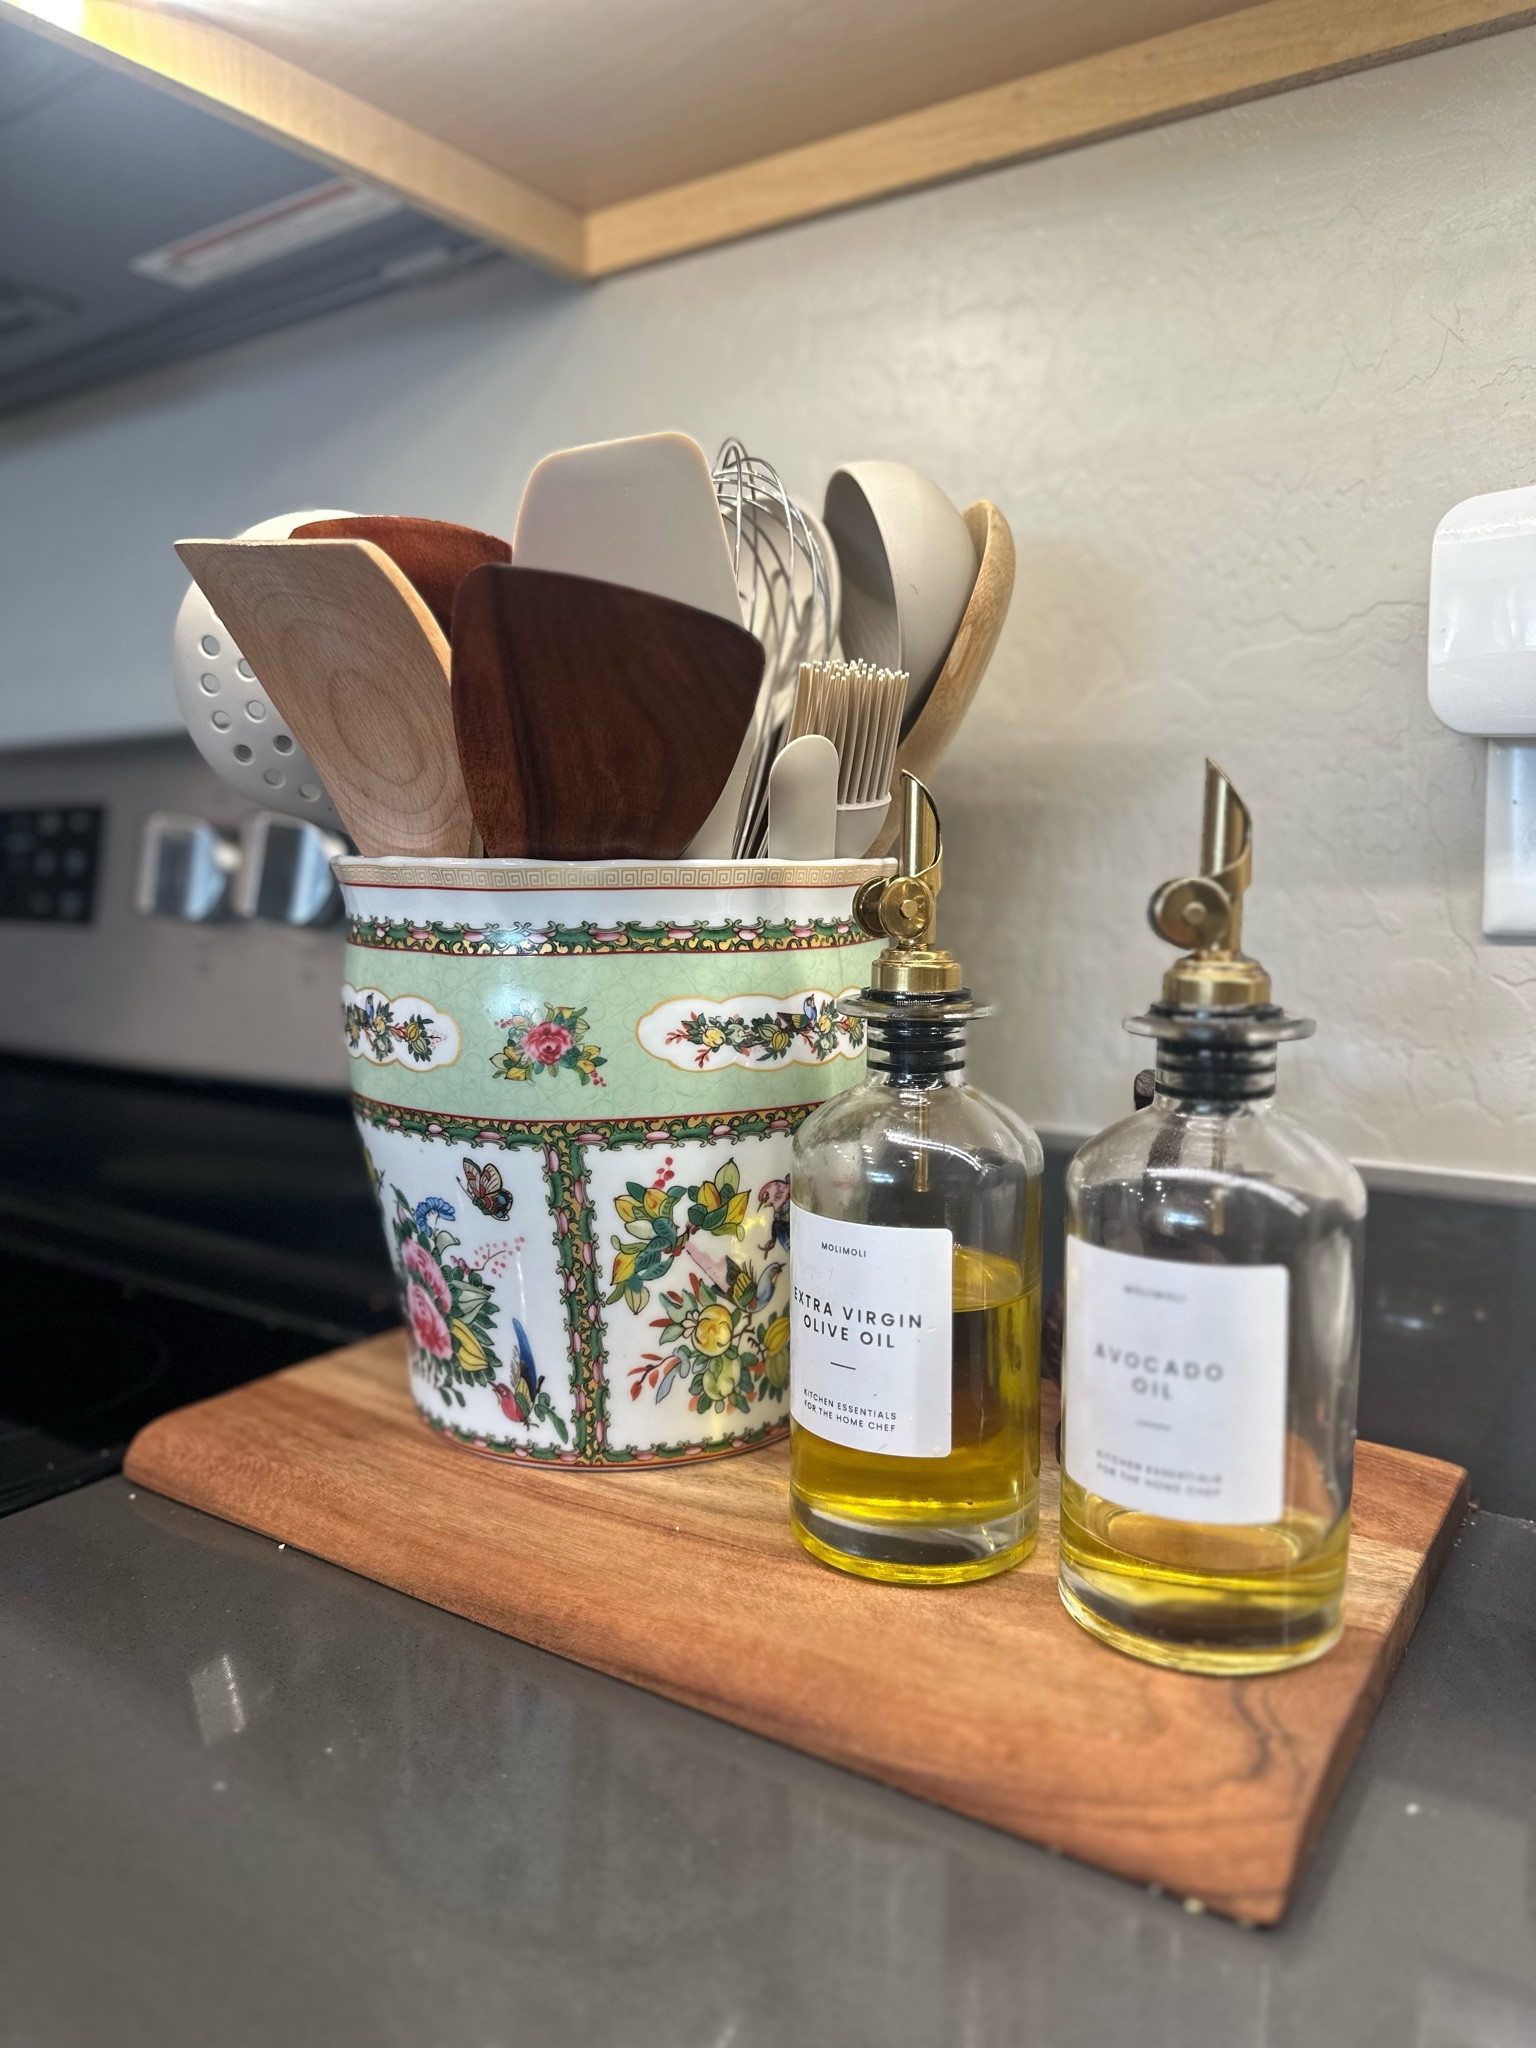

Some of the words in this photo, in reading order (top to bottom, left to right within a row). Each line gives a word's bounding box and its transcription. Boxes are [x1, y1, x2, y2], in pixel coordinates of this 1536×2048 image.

[821, 1241, 867, 1258] MOLIMOLI
[793, 1286, 833, 1317] EXTRA
[842, 1306, 923, 1329] VIRGIN
[803, 1314, 849, 1342] OLIVE
[859, 1331, 895, 1349] OIL
[1094, 1342, 1224, 1382] AVOCADO
[803, 1387, 834, 1408] KITCHEN
[837, 1401, 897, 1421] ESSENTIALS
[1132, 1377, 1172, 1400] OIL
[804, 1399, 817, 1413] FOR
[818, 1407, 834, 1420] THE
[836, 1413, 864, 1429] HOME
[867, 1420, 896, 1433] CHEF
